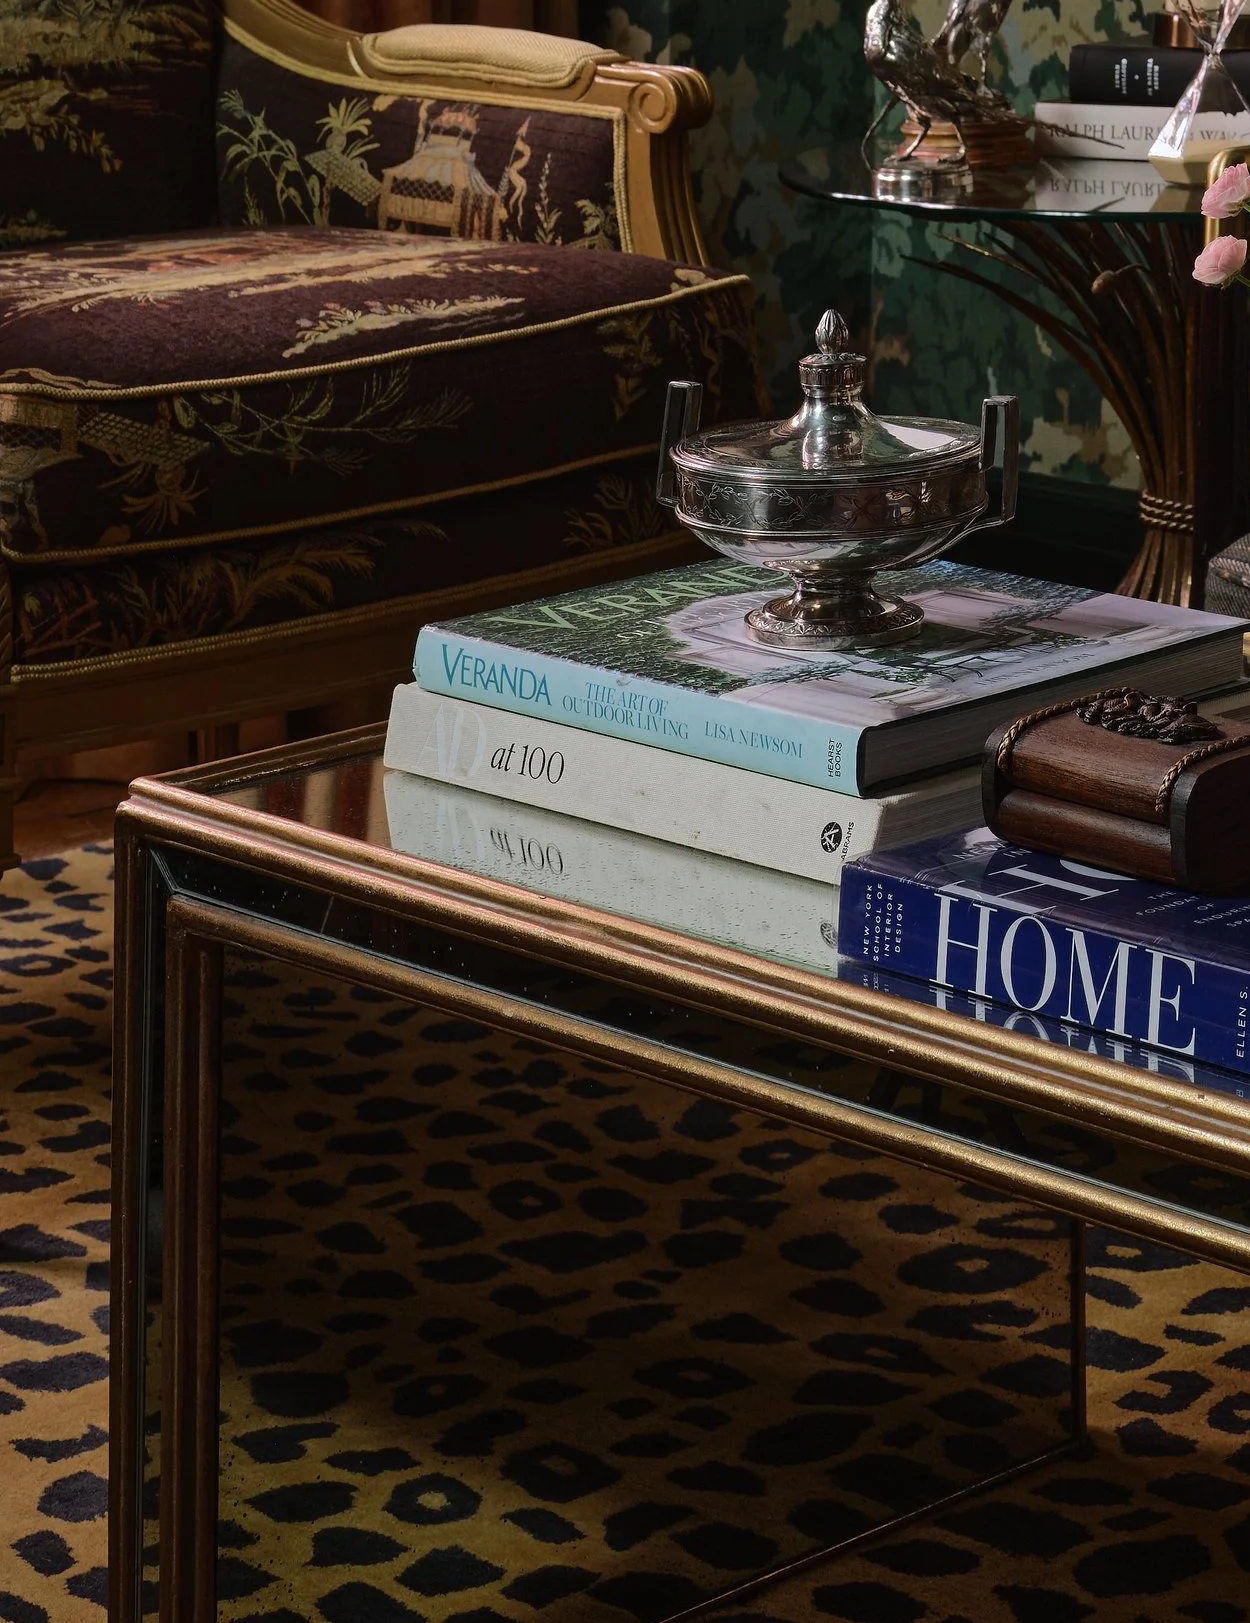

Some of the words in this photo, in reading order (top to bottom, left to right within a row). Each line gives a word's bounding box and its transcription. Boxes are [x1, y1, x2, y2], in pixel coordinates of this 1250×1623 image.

[1051, 123, 1104, 141] RALPH
[483, 565, 792, 628] VERAND
[441, 643, 552, 706] VERANDA
[562, 695, 635, 727] OUTDOOR
[637, 712, 689, 740] LIVING
[585, 682, 616, 703] THE
[618, 692, 649, 711] ART
[649, 698, 669, 716] OF
[411, 703, 487, 778] AD
[705, 721, 736, 744] LISA
[739, 728, 803, 758] NEWSOM
[835, 742, 843, 777] BOOKS
[490, 743, 516, 772] at
[517, 744, 565, 784] 100
[840, 821, 855, 863] ABRAMS
[865, 884, 873, 918] YORK
[877, 883, 883, 900] OF
[1148, 890, 1177, 901] THE
[1197, 902, 1215, 911] OF
[863, 926, 871, 955] NEW
[873, 907, 882, 961] SCHOOL
[884, 893, 894, 957] INTERIOR
[895, 903, 904, 953] DESIGN
[929, 892, 1196, 1056] HOME
[1240, 986, 1249, 1000] S.
[1236, 1006, 1247, 1058] ELLEN
